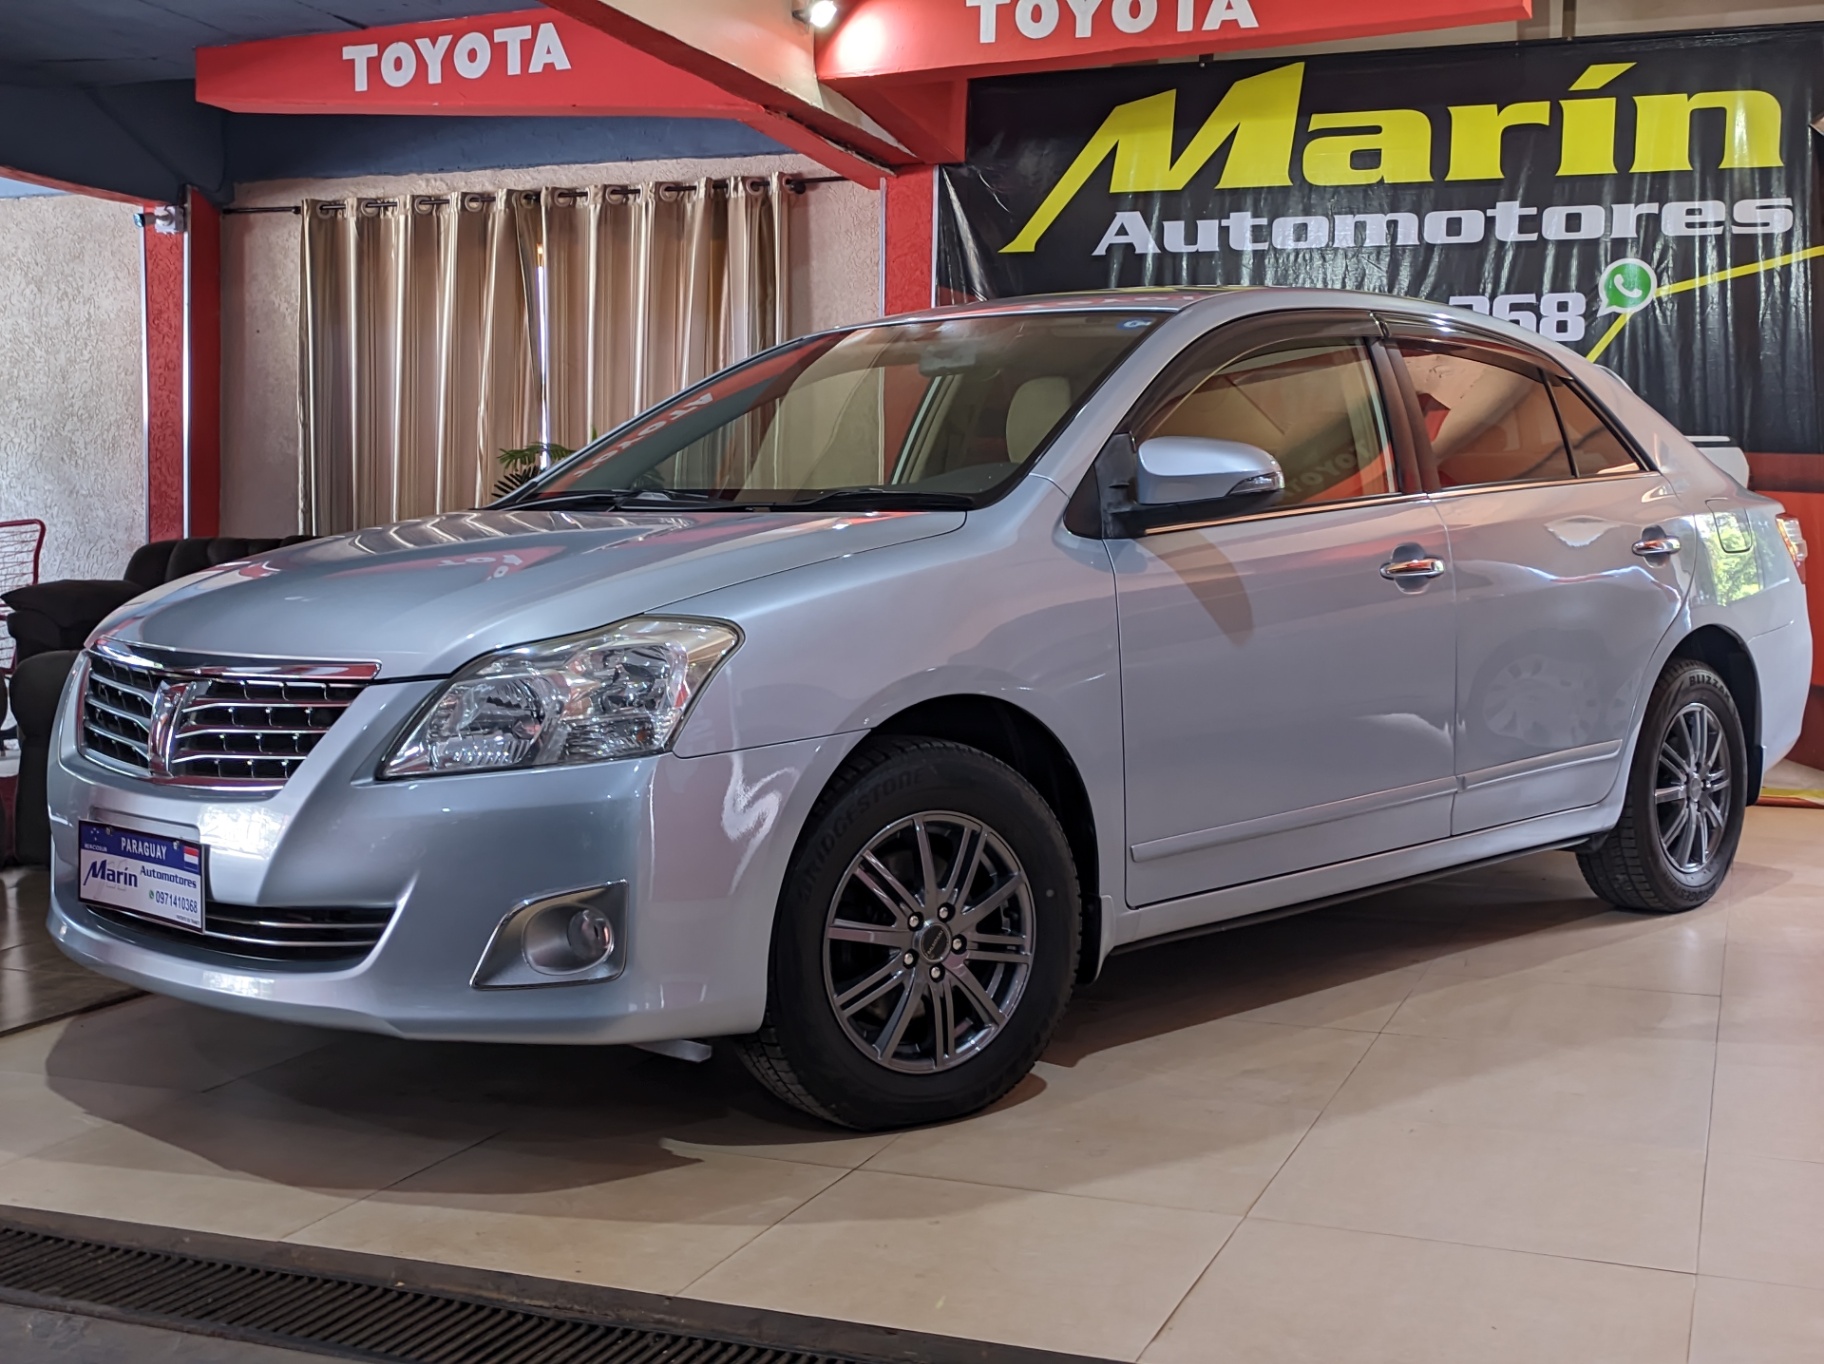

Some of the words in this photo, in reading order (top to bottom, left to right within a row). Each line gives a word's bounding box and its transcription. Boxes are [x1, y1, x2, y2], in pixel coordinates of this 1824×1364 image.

[342, 22, 571, 92] TOYOTA
[997, 61, 1785, 254] Marín
[1092, 197, 1795, 256] Automotores
[121, 837, 167, 860] PARAGUAY
[83, 859, 138, 888] Marín
[140, 865, 197, 889] Automotores
[155, 890, 198, 914] 0971410368
